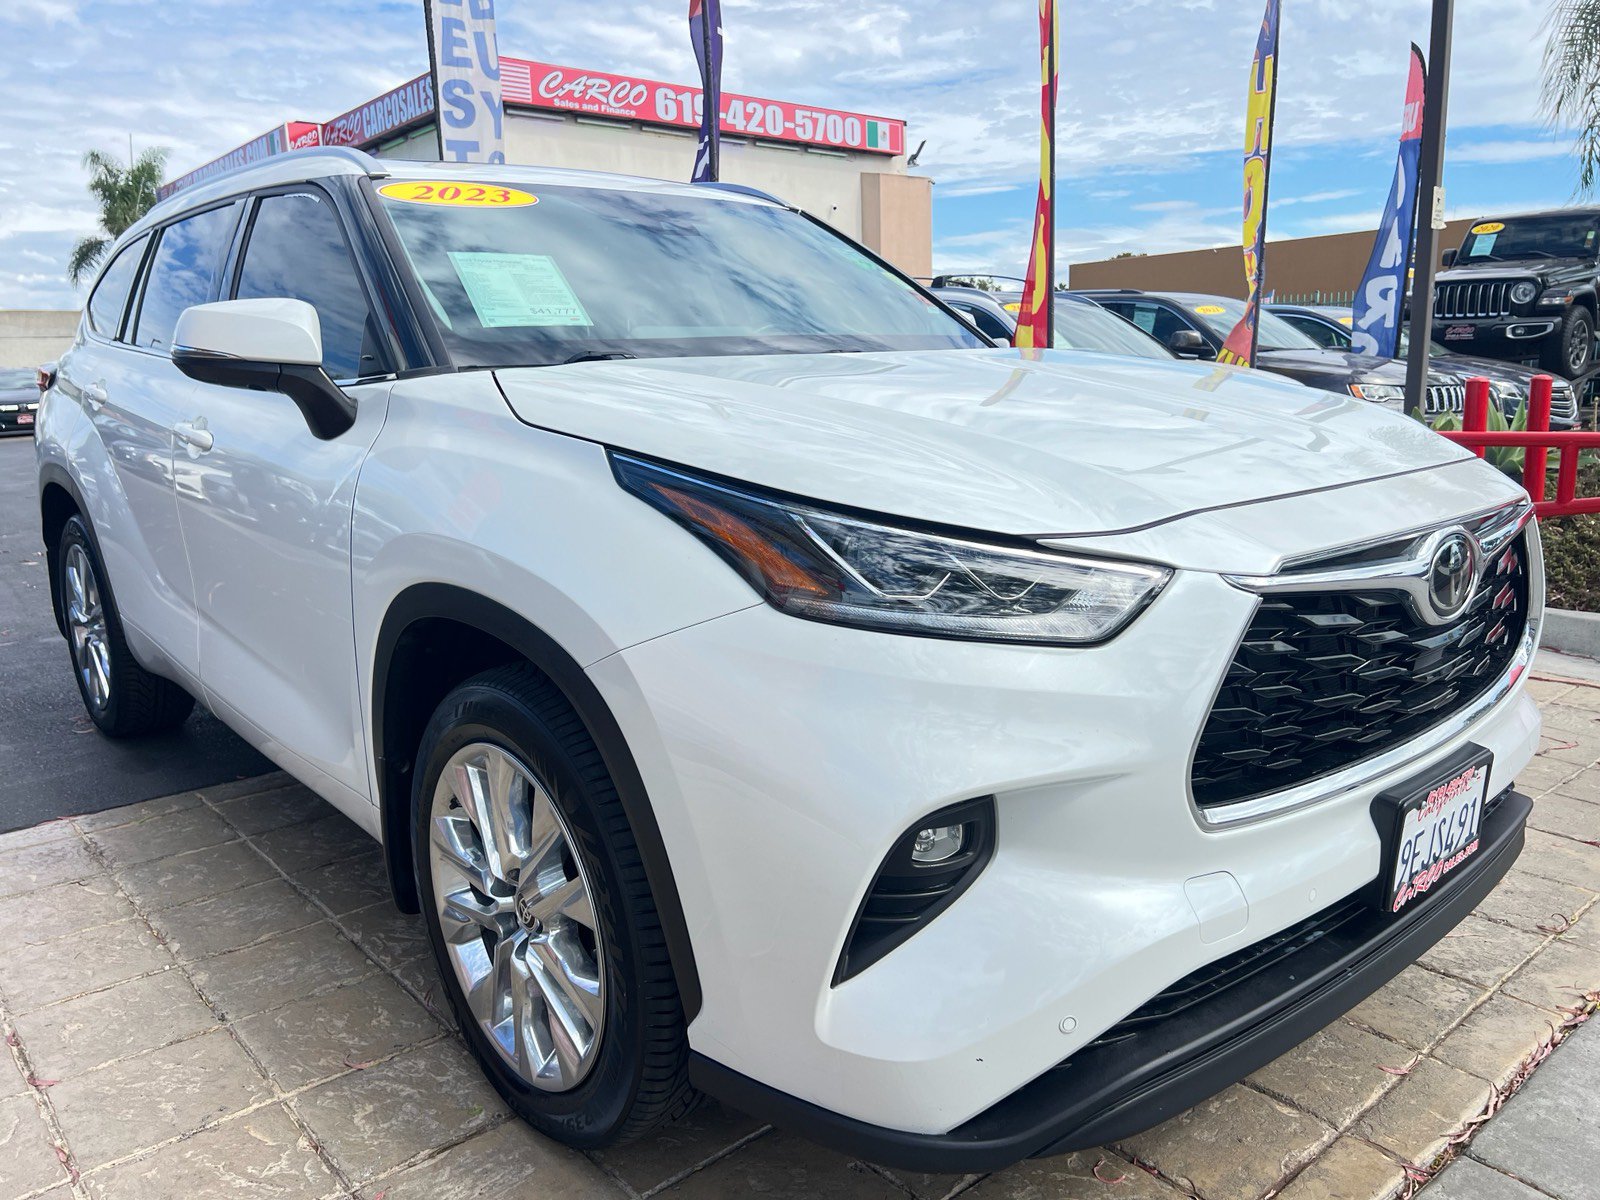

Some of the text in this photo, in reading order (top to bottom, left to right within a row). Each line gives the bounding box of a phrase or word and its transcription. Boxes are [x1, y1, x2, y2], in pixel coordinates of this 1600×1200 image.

[537, 70, 862, 147] CARCO 619-420-5700
[553, 98, 637, 117] Sales and Finance
[410, 184, 512, 204] 2023
[1397, 796, 1479, 889] 9EJS491
